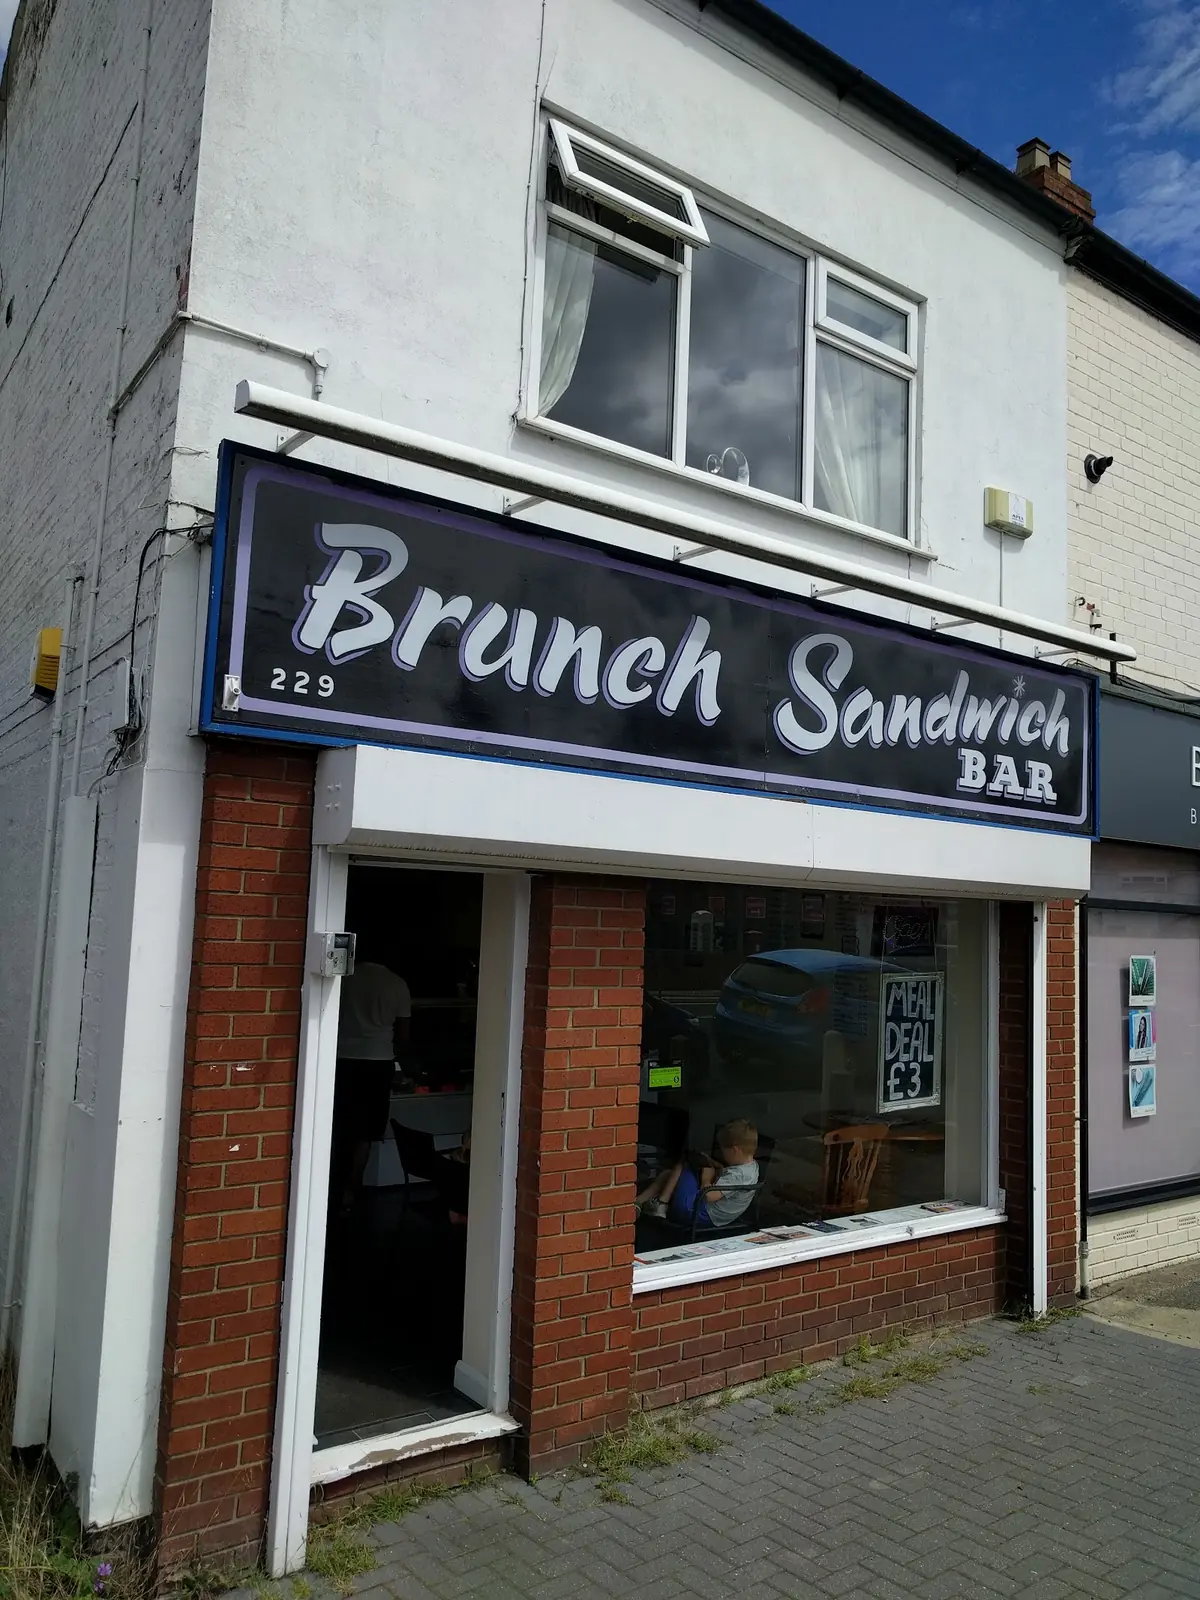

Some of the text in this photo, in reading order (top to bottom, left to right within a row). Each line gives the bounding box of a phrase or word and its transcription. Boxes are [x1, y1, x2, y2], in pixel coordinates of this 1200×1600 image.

[292, 521, 1070, 758] Brunch Sandwich
[270, 667, 335, 698] 229
[956, 748, 1057, 805] BAR
[886, 980, 935, 1021] MEAL
[885, 1020, 934, 1063] DEAL
[886, 1061, 922, 1101] £3
